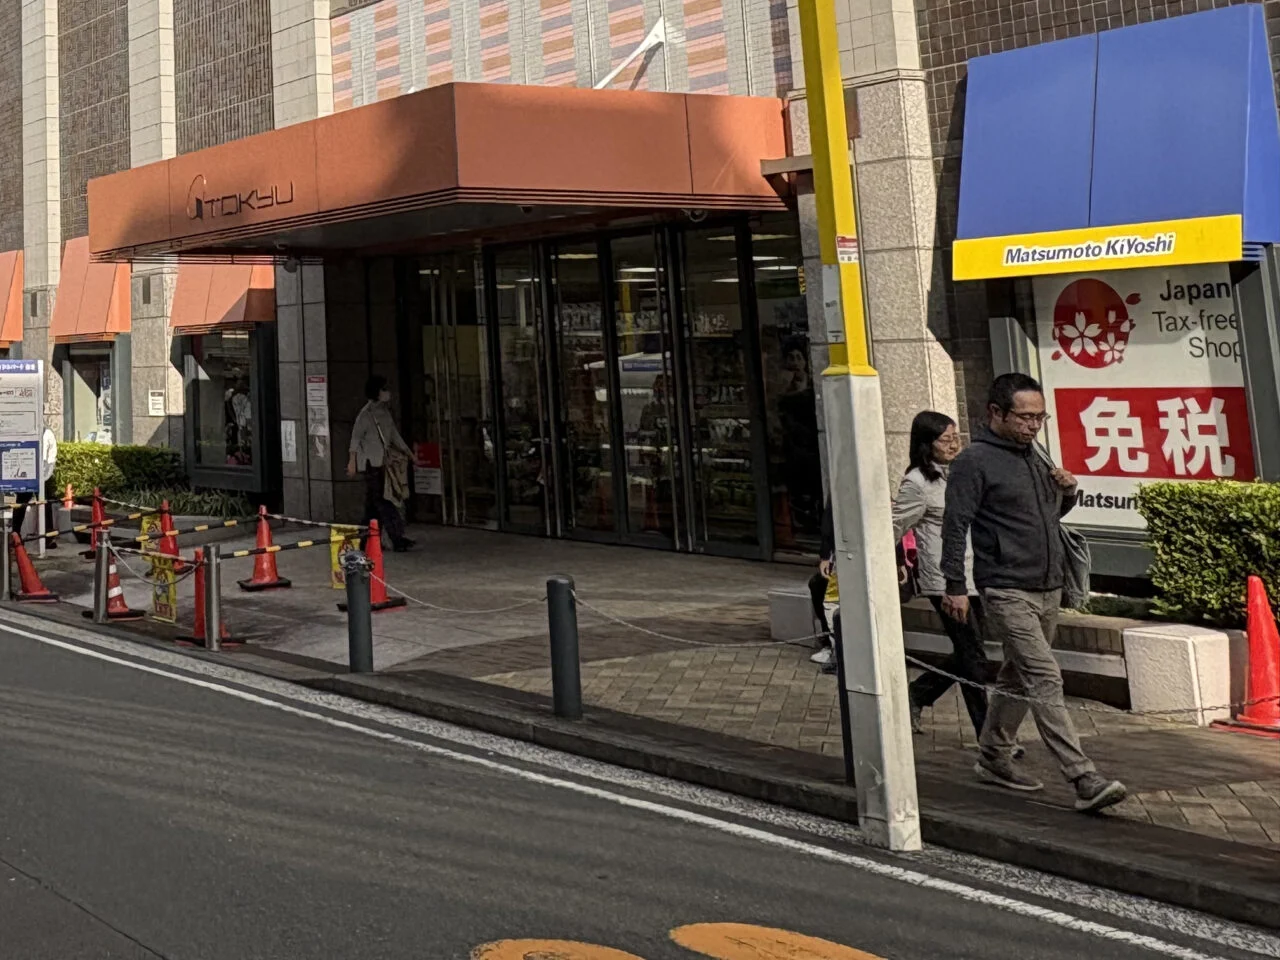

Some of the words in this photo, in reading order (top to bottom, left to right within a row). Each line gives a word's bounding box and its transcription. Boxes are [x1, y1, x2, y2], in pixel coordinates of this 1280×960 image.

[204, 180, 294, 218] TOKYU
[1005, 243, 1103, 264] Matsumoto
[1104, 235, 1174, 256] KiYoshi
[1160, 279, 1231, 305] Japan
[1151, 309, 1238, 333] Tax-free
[1189, 336, 1241, 363] Shop
[1079, 396, 1236, 477] 免税
